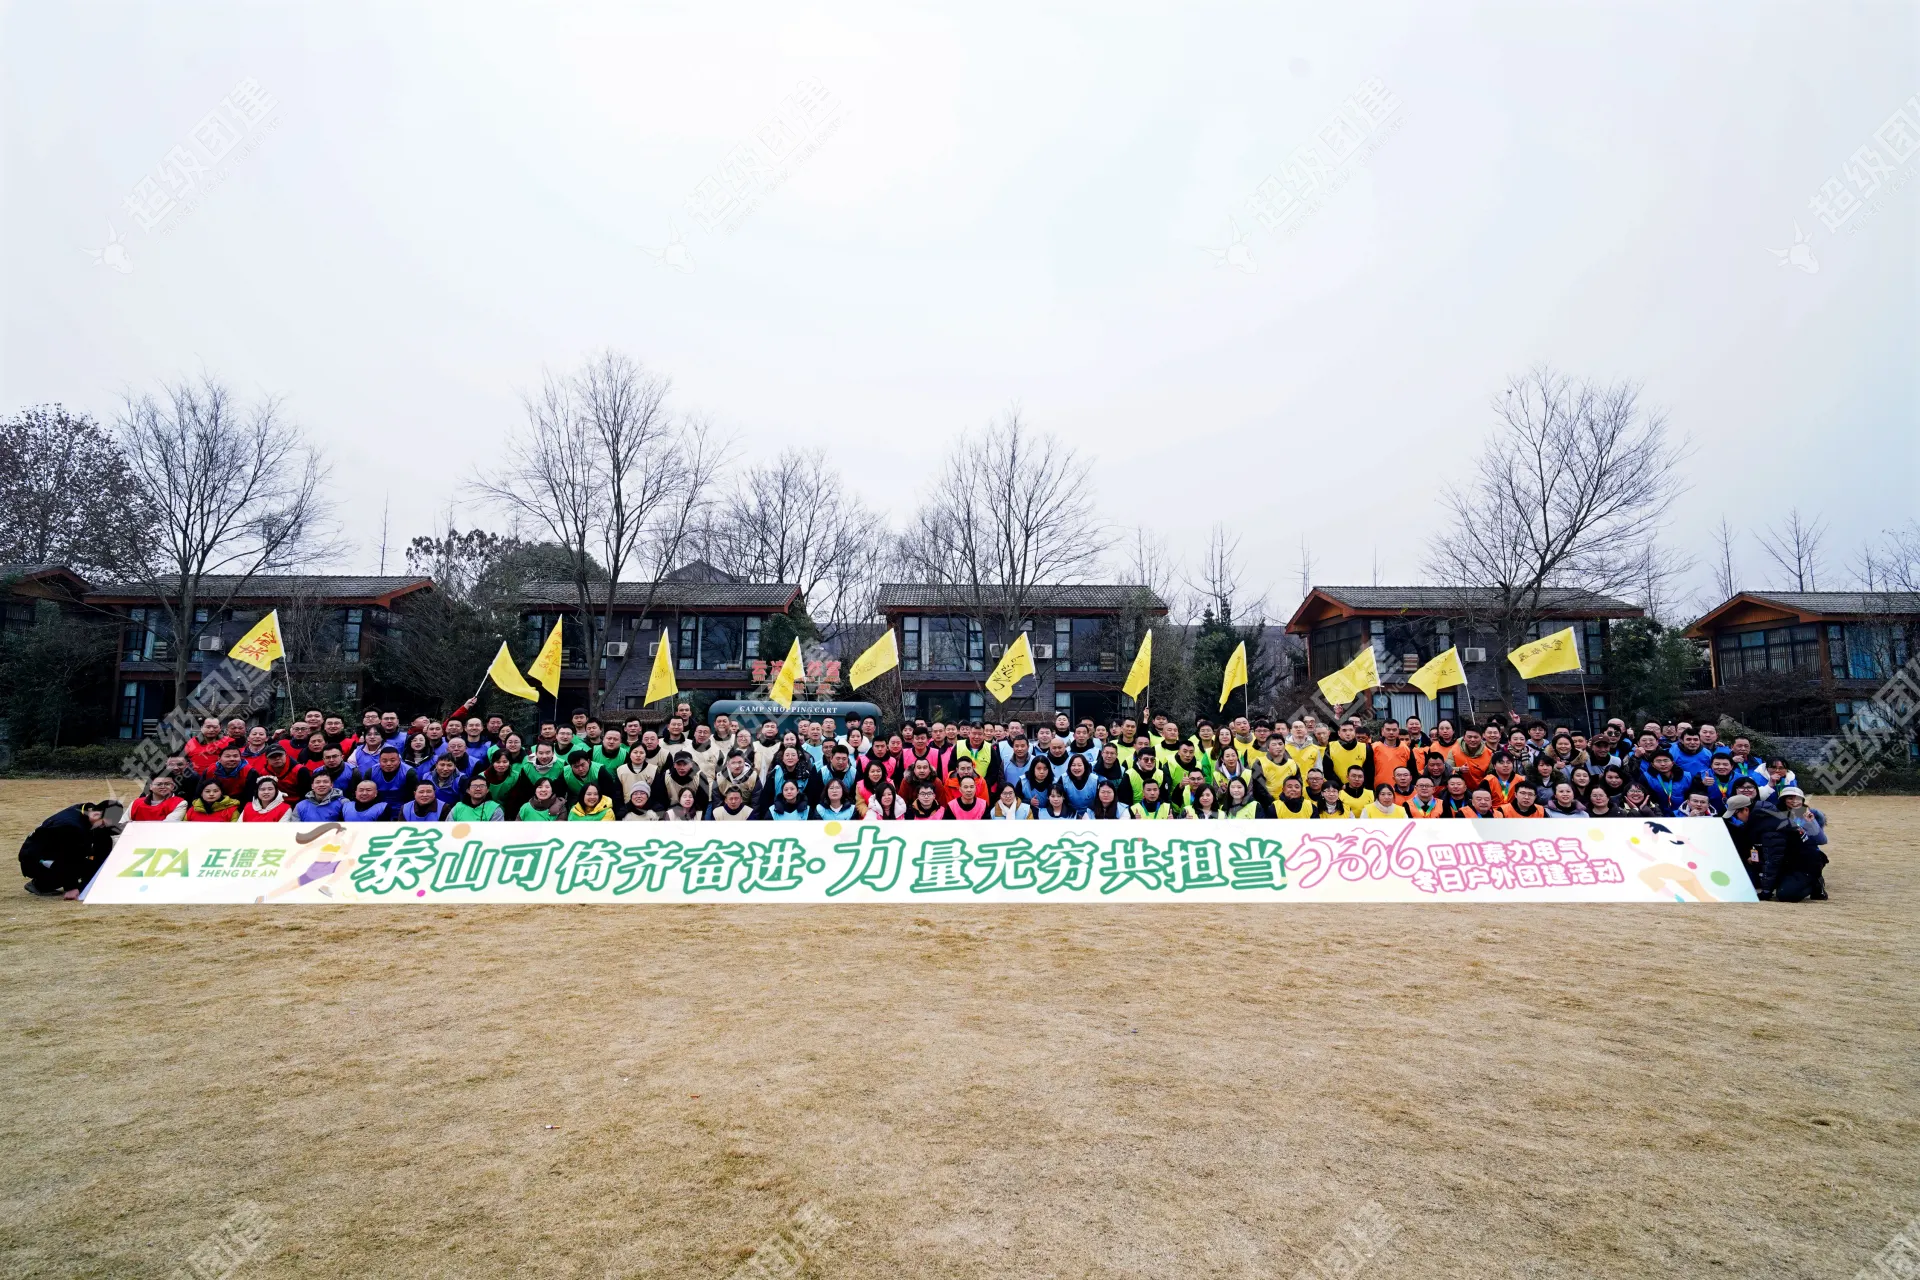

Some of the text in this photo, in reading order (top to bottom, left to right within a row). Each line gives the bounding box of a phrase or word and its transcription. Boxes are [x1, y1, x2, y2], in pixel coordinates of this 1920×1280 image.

[739, 705, 765, 713] CAMP
[814, 706, 838, 714] CART
[116, 848, 189, 878] ZDA
[200, 847, 287, 868] 正德安
[1428, 837, 1588, 868] 四川泰力电气
[196, 869, 240, 878] ZHENG
[1412, 858, 1625, 893] 冬日户外团建活动
